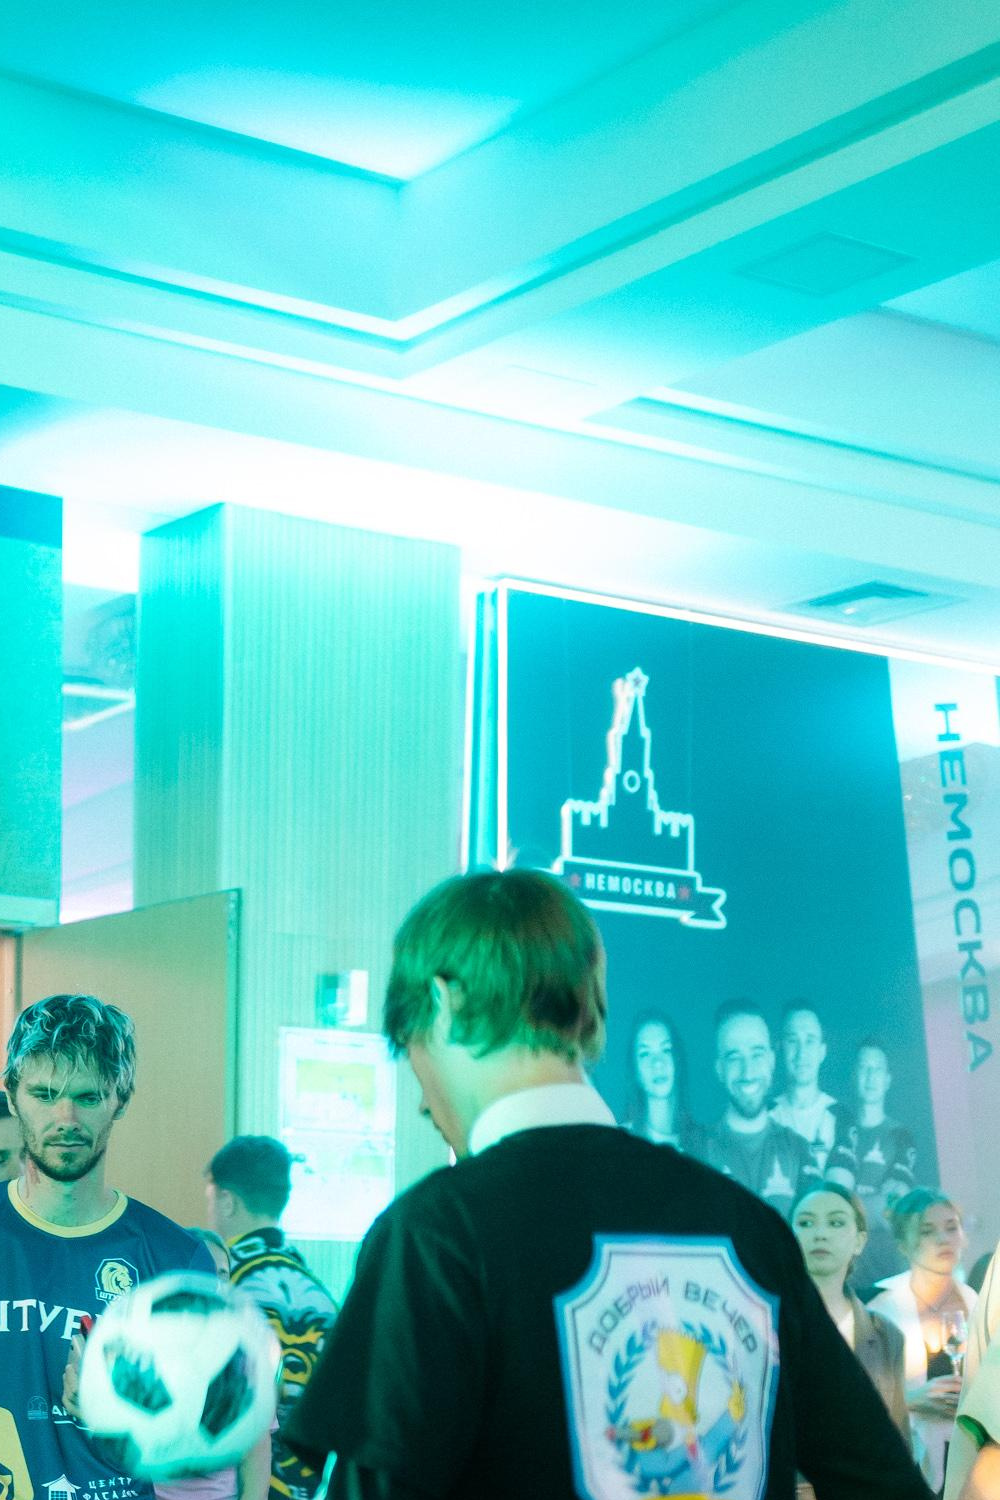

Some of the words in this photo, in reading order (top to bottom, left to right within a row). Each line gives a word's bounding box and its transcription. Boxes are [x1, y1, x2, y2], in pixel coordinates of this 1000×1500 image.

[585, 872, 676, 899] НЕМОСКВА
[934, 703, 994, 1072] НЕМОСКВА
[684, 1280, 758, 1353] ВЕЧЕР
